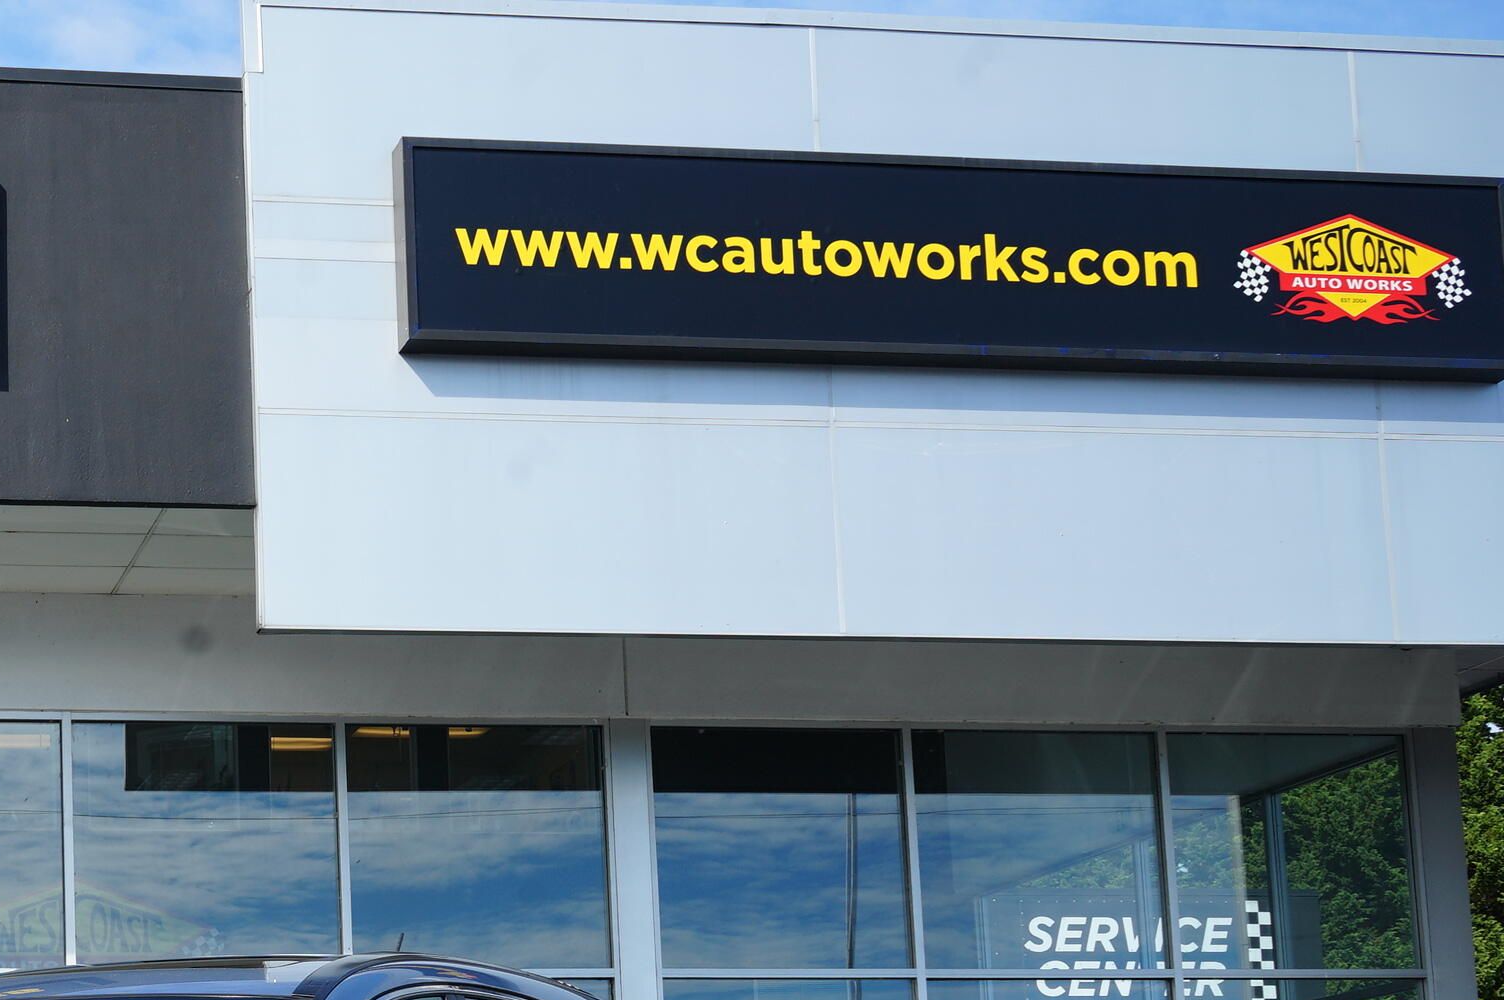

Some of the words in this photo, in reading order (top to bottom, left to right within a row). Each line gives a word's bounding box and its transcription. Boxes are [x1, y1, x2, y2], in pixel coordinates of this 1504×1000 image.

[455, 227, 1199, 288] www.wcautoworks.com
[1292, 276, 1342, 289] AUTO
[1346, 278, 1414, 292] WORKS
[1036, 960, 1227, 997] CENER
